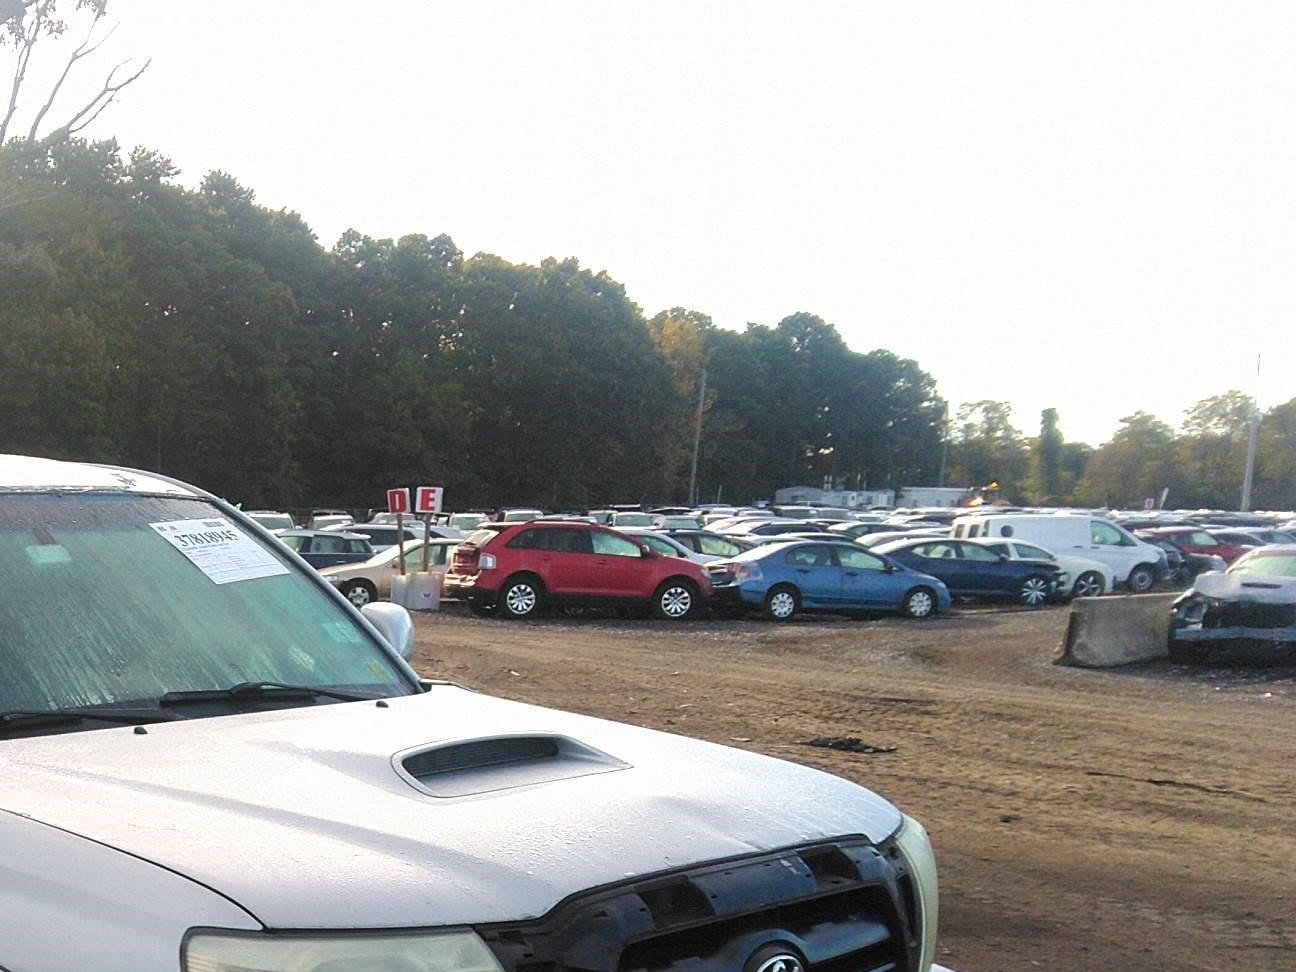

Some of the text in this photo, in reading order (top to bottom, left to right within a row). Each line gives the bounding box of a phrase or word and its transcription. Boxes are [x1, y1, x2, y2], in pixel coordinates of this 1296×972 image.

[390, 490, 407, 513] D
[420, 489, 436, 511] E
[174, 530, 239, 547] 37818945
